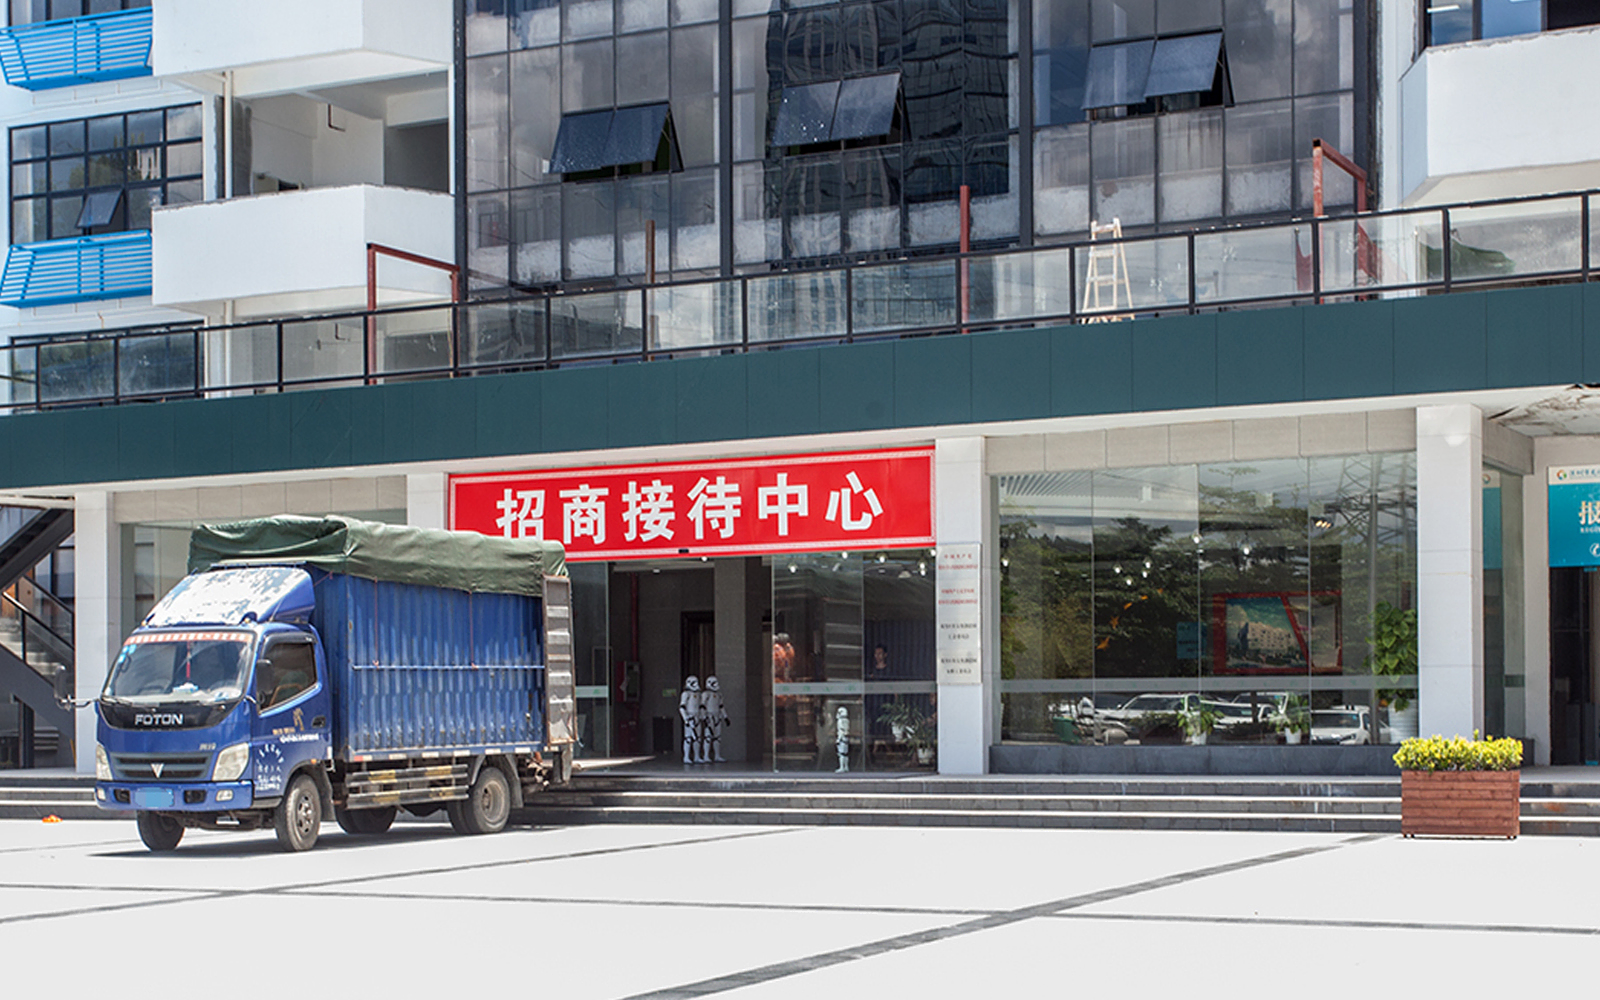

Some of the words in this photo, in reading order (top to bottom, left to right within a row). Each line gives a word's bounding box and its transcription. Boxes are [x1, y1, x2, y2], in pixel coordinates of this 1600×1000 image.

[496, 471, 884, 545] 招商接待中心
[134, 713, 184, 726] FOTON
